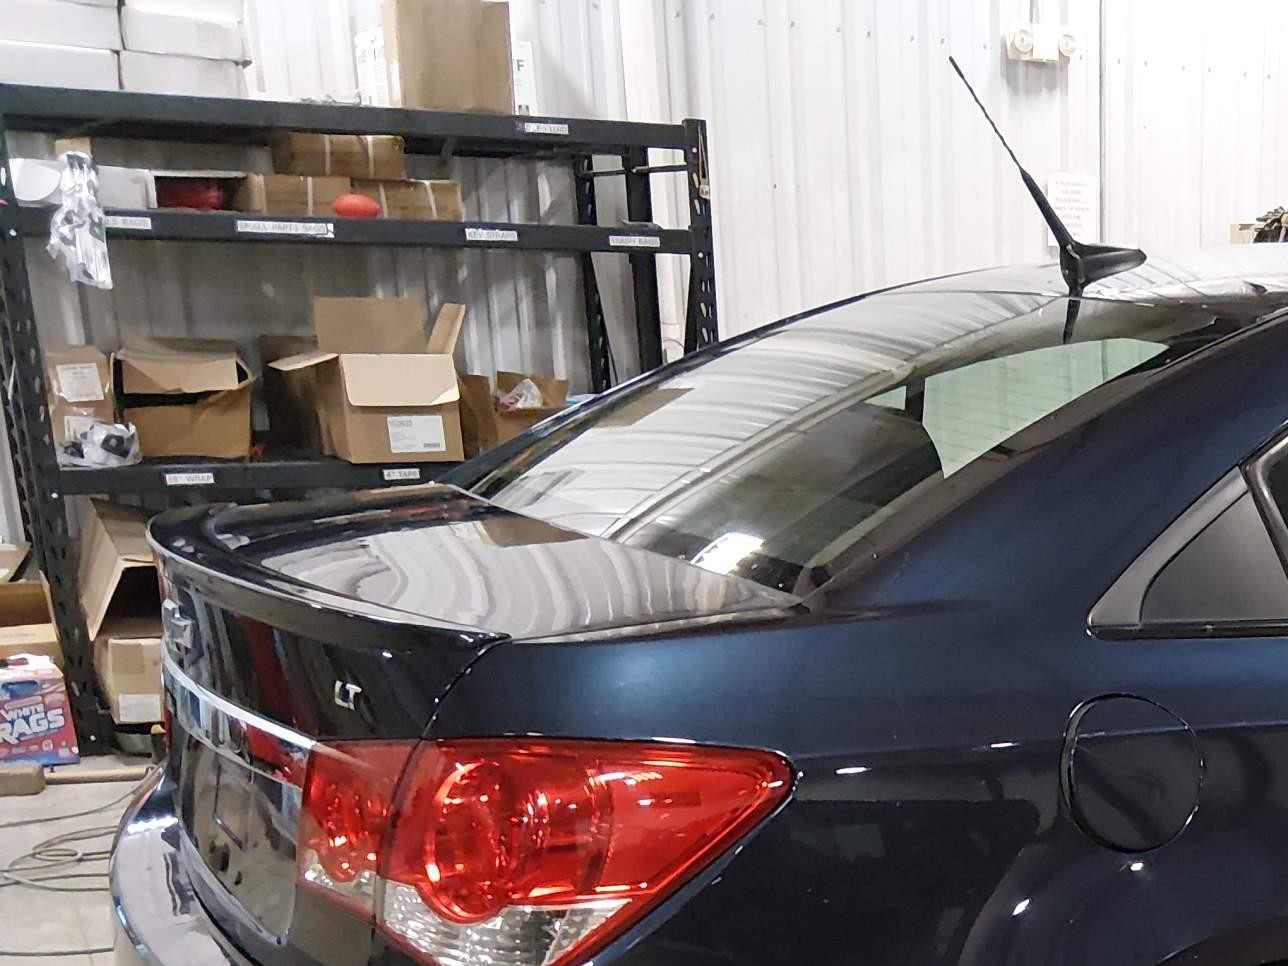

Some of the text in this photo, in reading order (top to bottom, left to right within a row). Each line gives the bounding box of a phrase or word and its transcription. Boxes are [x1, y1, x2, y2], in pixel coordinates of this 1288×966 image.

[334, 679, 363, 711] LT
[0, 703, 45, 721] WHITE
[0, 707, 65, 745] RAGS
